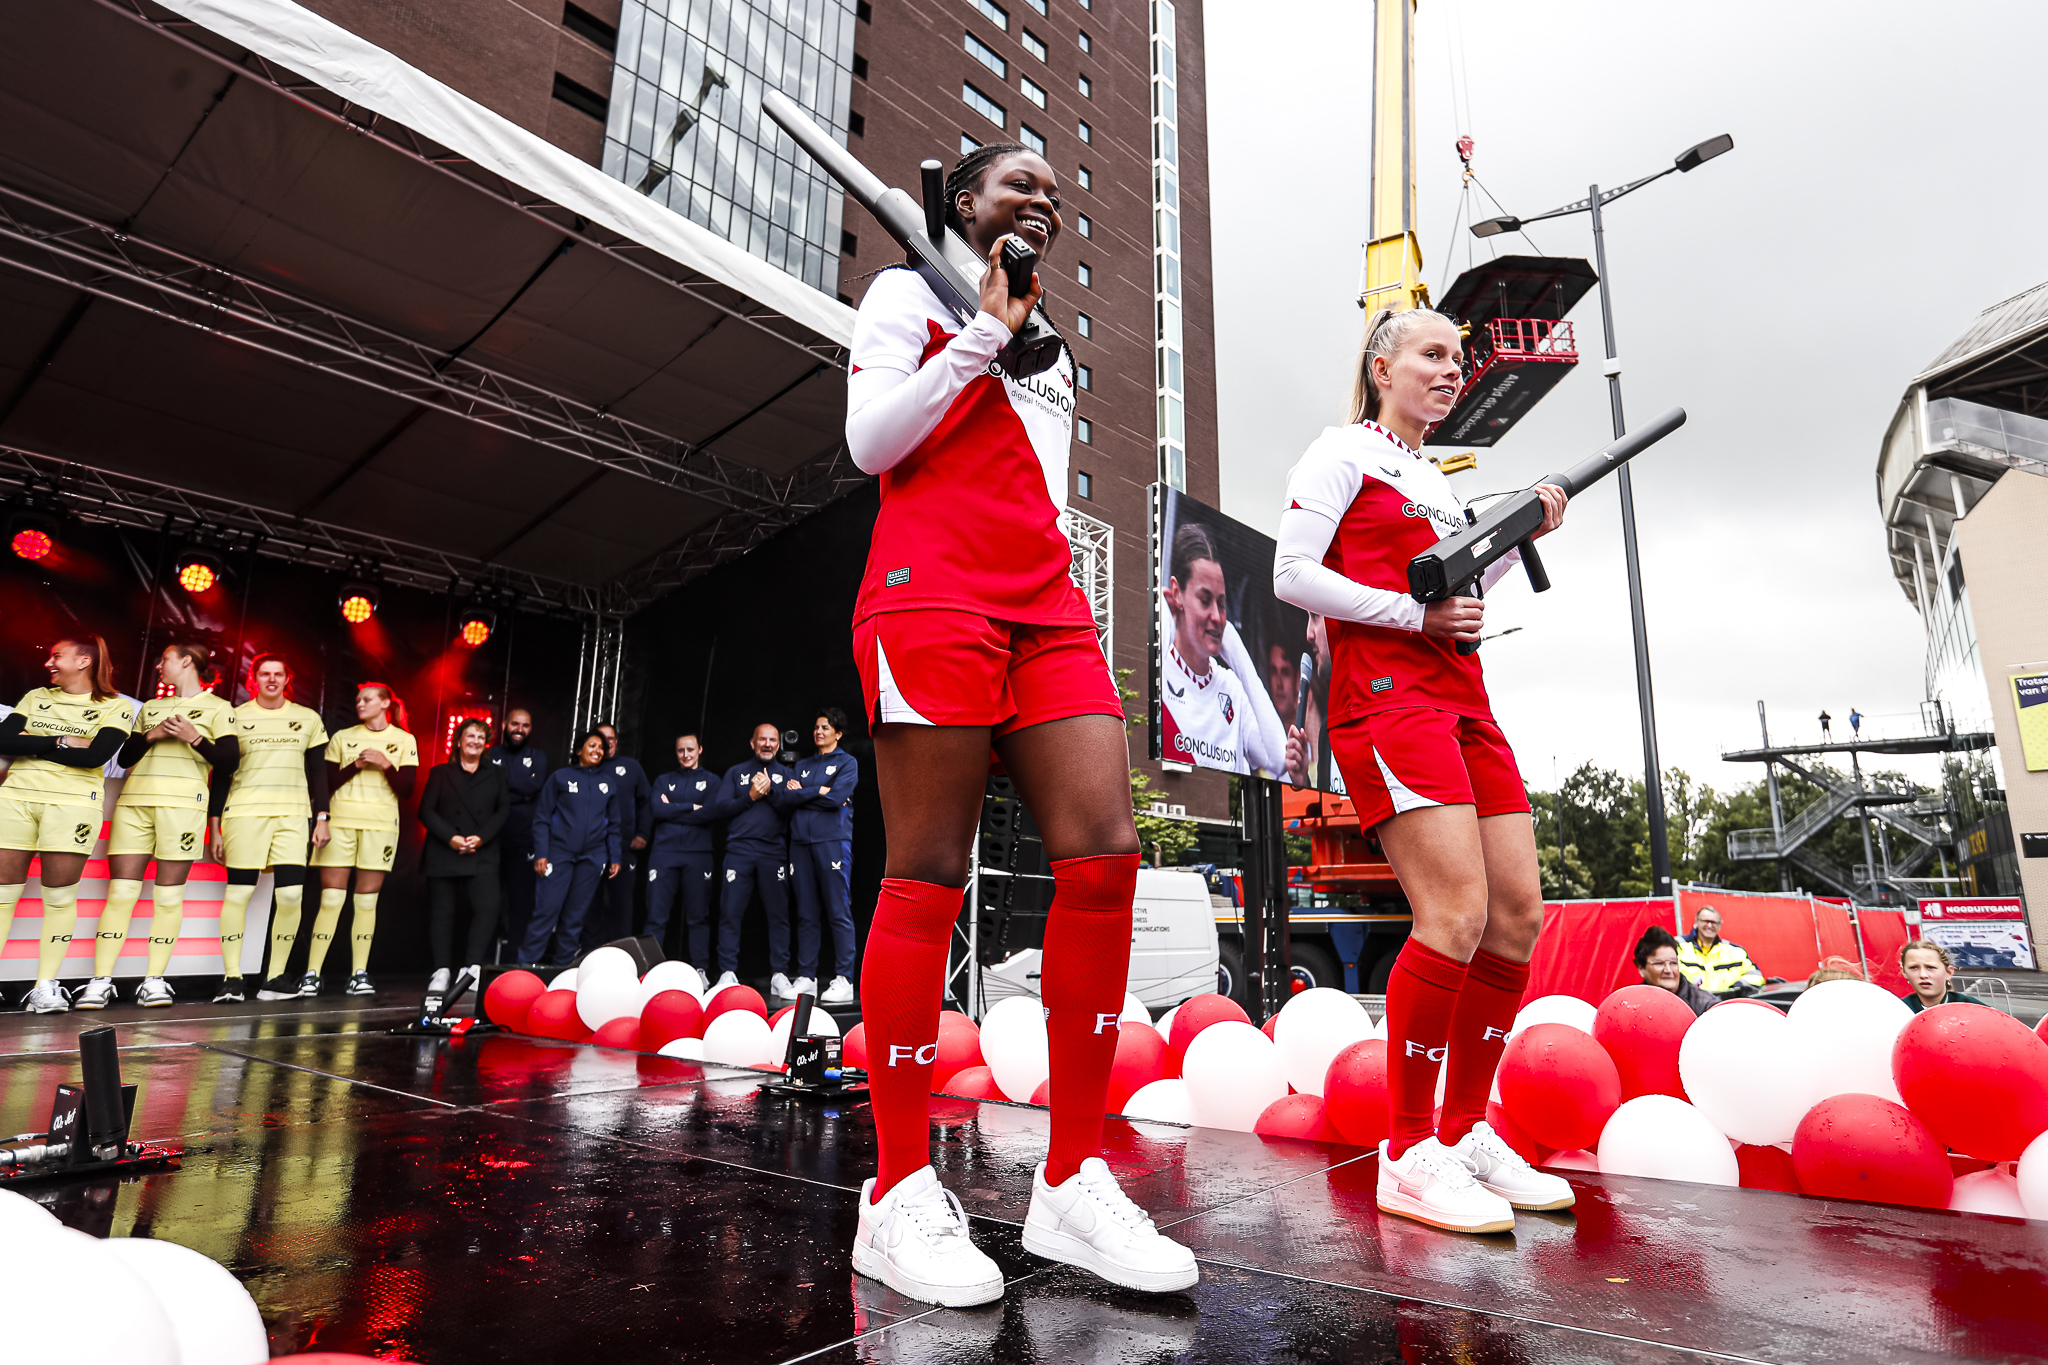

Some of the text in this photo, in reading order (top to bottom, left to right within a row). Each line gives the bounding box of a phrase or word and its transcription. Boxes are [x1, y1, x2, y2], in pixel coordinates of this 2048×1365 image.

[1011, 389, 1033, 405] digital
[2019, 685, 2048, 696] van F
[31, 720, 88, 735] CONCLUSION
[249, 737, 300, 745] CONCLUSION
[1174, 732, 1237, 763] CONCLUSION
[1945, 905, 2020, 913] NOODUITGANG
[96, 931, 123, 940] FCU
[149, 936, 175, 945] FCU
[221, 932, 244, 943] FCU
